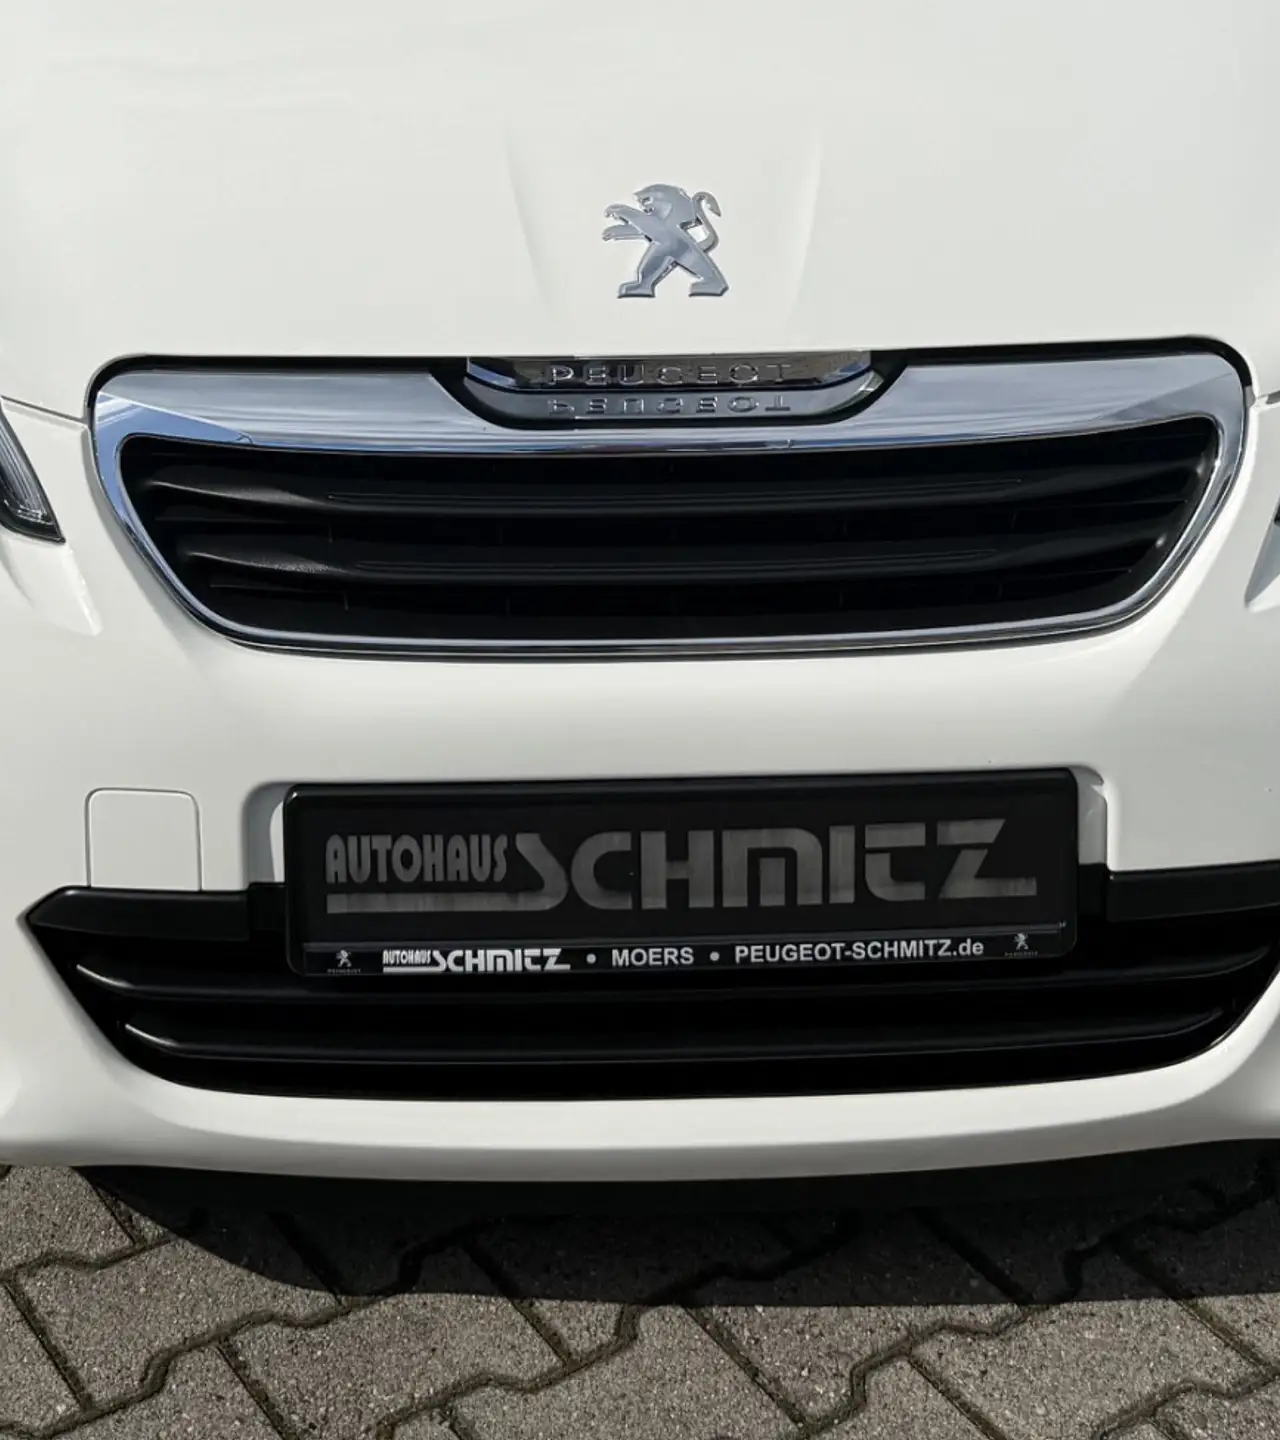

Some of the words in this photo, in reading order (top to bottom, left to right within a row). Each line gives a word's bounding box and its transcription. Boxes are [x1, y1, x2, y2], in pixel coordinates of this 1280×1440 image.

[548, 363, 791, 386] PEUGEOT
[325, 833, 508, 884] AUTOHAUS
[516, 818, 1037, 911] SCHMITZ
[382, 949, 431, 964] AUTOHAUS
[433, 948, 571, 973] SCHMITZ
[611, 946, 694, 968] MOERS
[734, 938, 984, 964] PEUGEOT-SCHMITZ.de
